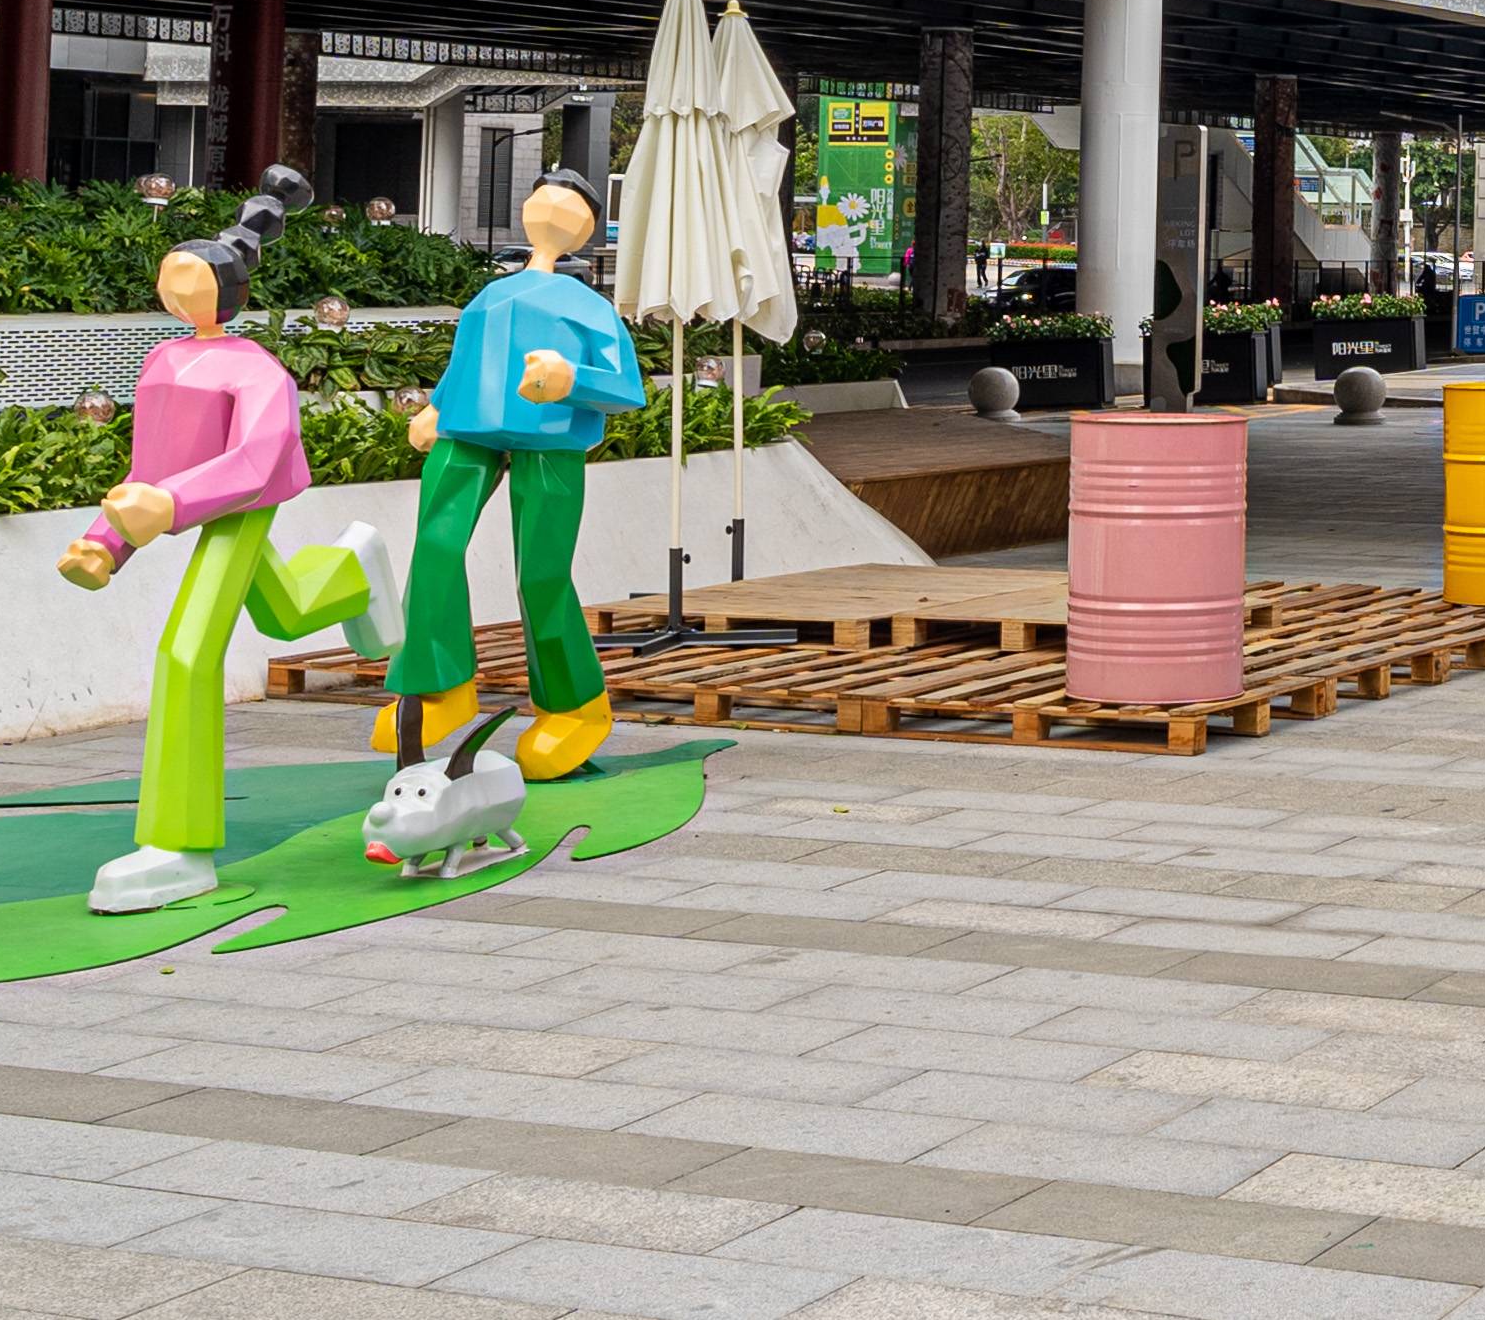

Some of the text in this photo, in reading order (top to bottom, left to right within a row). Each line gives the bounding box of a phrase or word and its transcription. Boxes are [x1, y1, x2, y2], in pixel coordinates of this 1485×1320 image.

[1174, 140, 1197, 181] P
[1332, 341, 1374, 355] 阳光里
